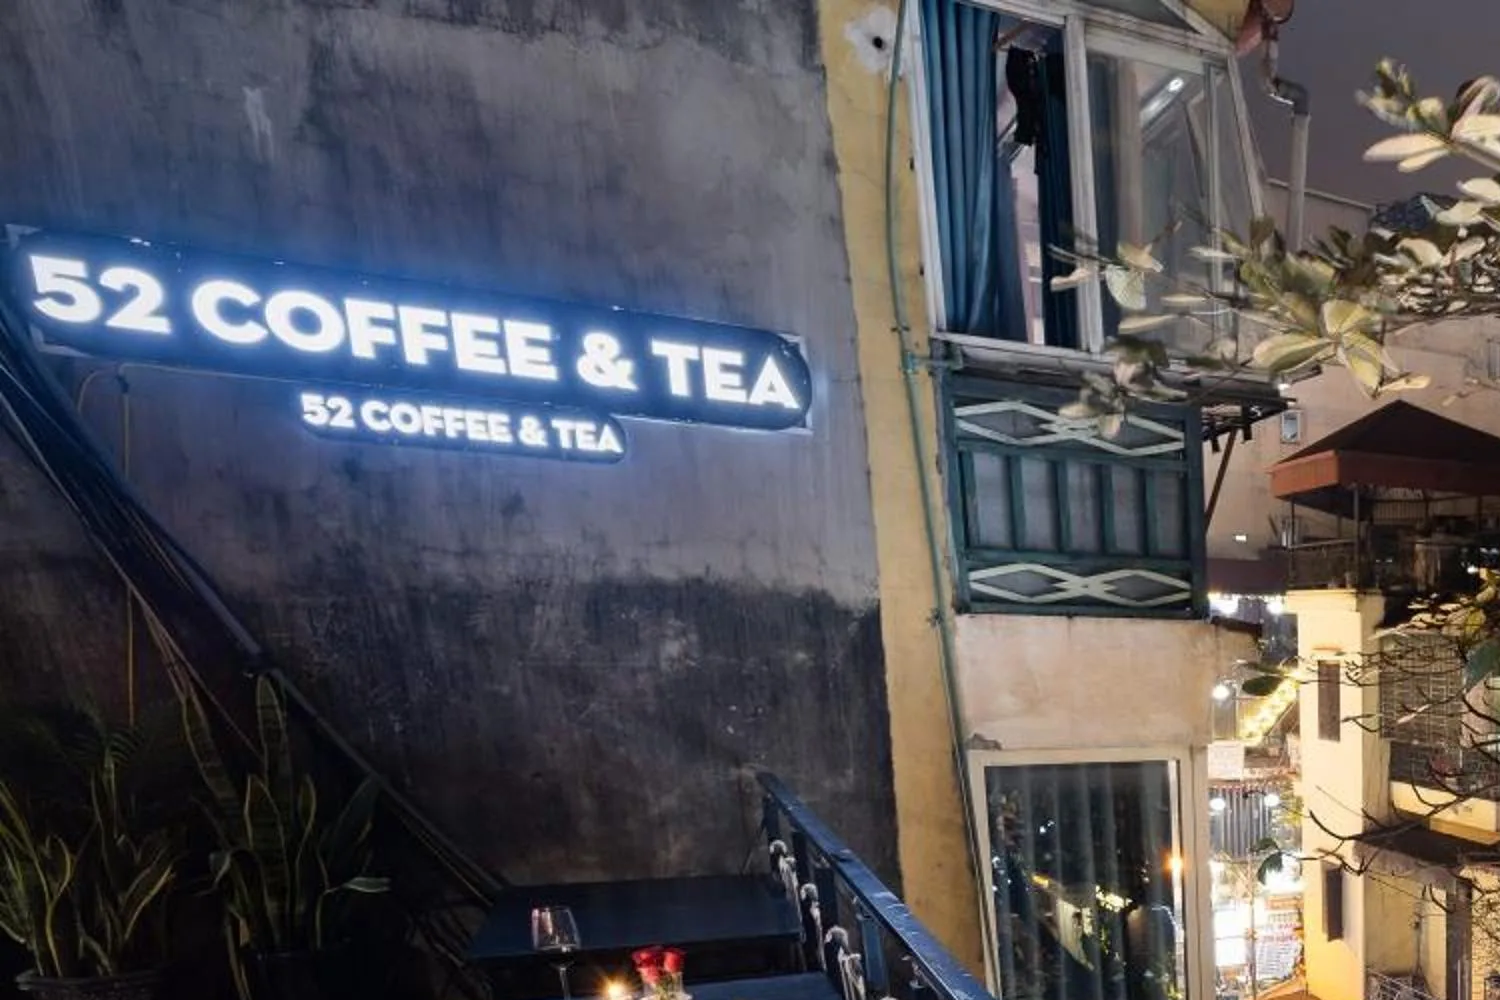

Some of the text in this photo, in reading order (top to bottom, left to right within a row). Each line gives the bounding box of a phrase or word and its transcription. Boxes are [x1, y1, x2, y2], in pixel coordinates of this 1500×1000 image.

[30, 255, 799, 410] 52 COFFEE & TEA
[300, 393, 623, 453] 52 COFFEE & TEA
